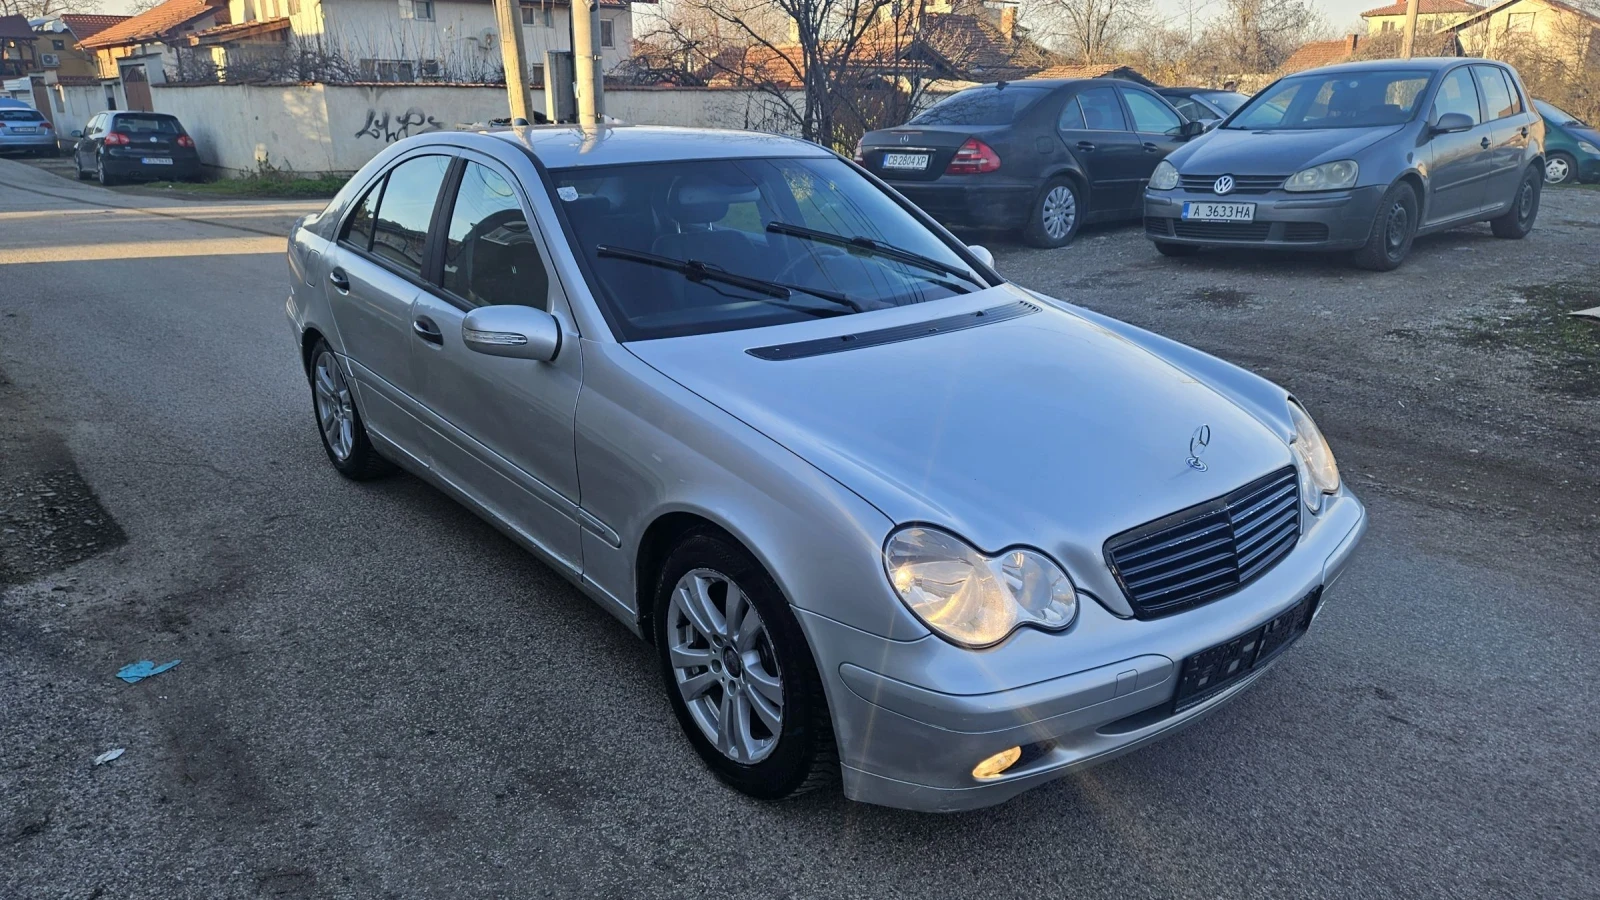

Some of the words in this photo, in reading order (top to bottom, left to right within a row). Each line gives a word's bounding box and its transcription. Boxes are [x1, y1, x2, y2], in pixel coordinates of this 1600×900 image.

[888, 155, 898, 165] CB
[1193, 205, 1200, 217] A
[1206, 205, 1234, 218] 3633
[1235, 206, 1250, 218] HA
